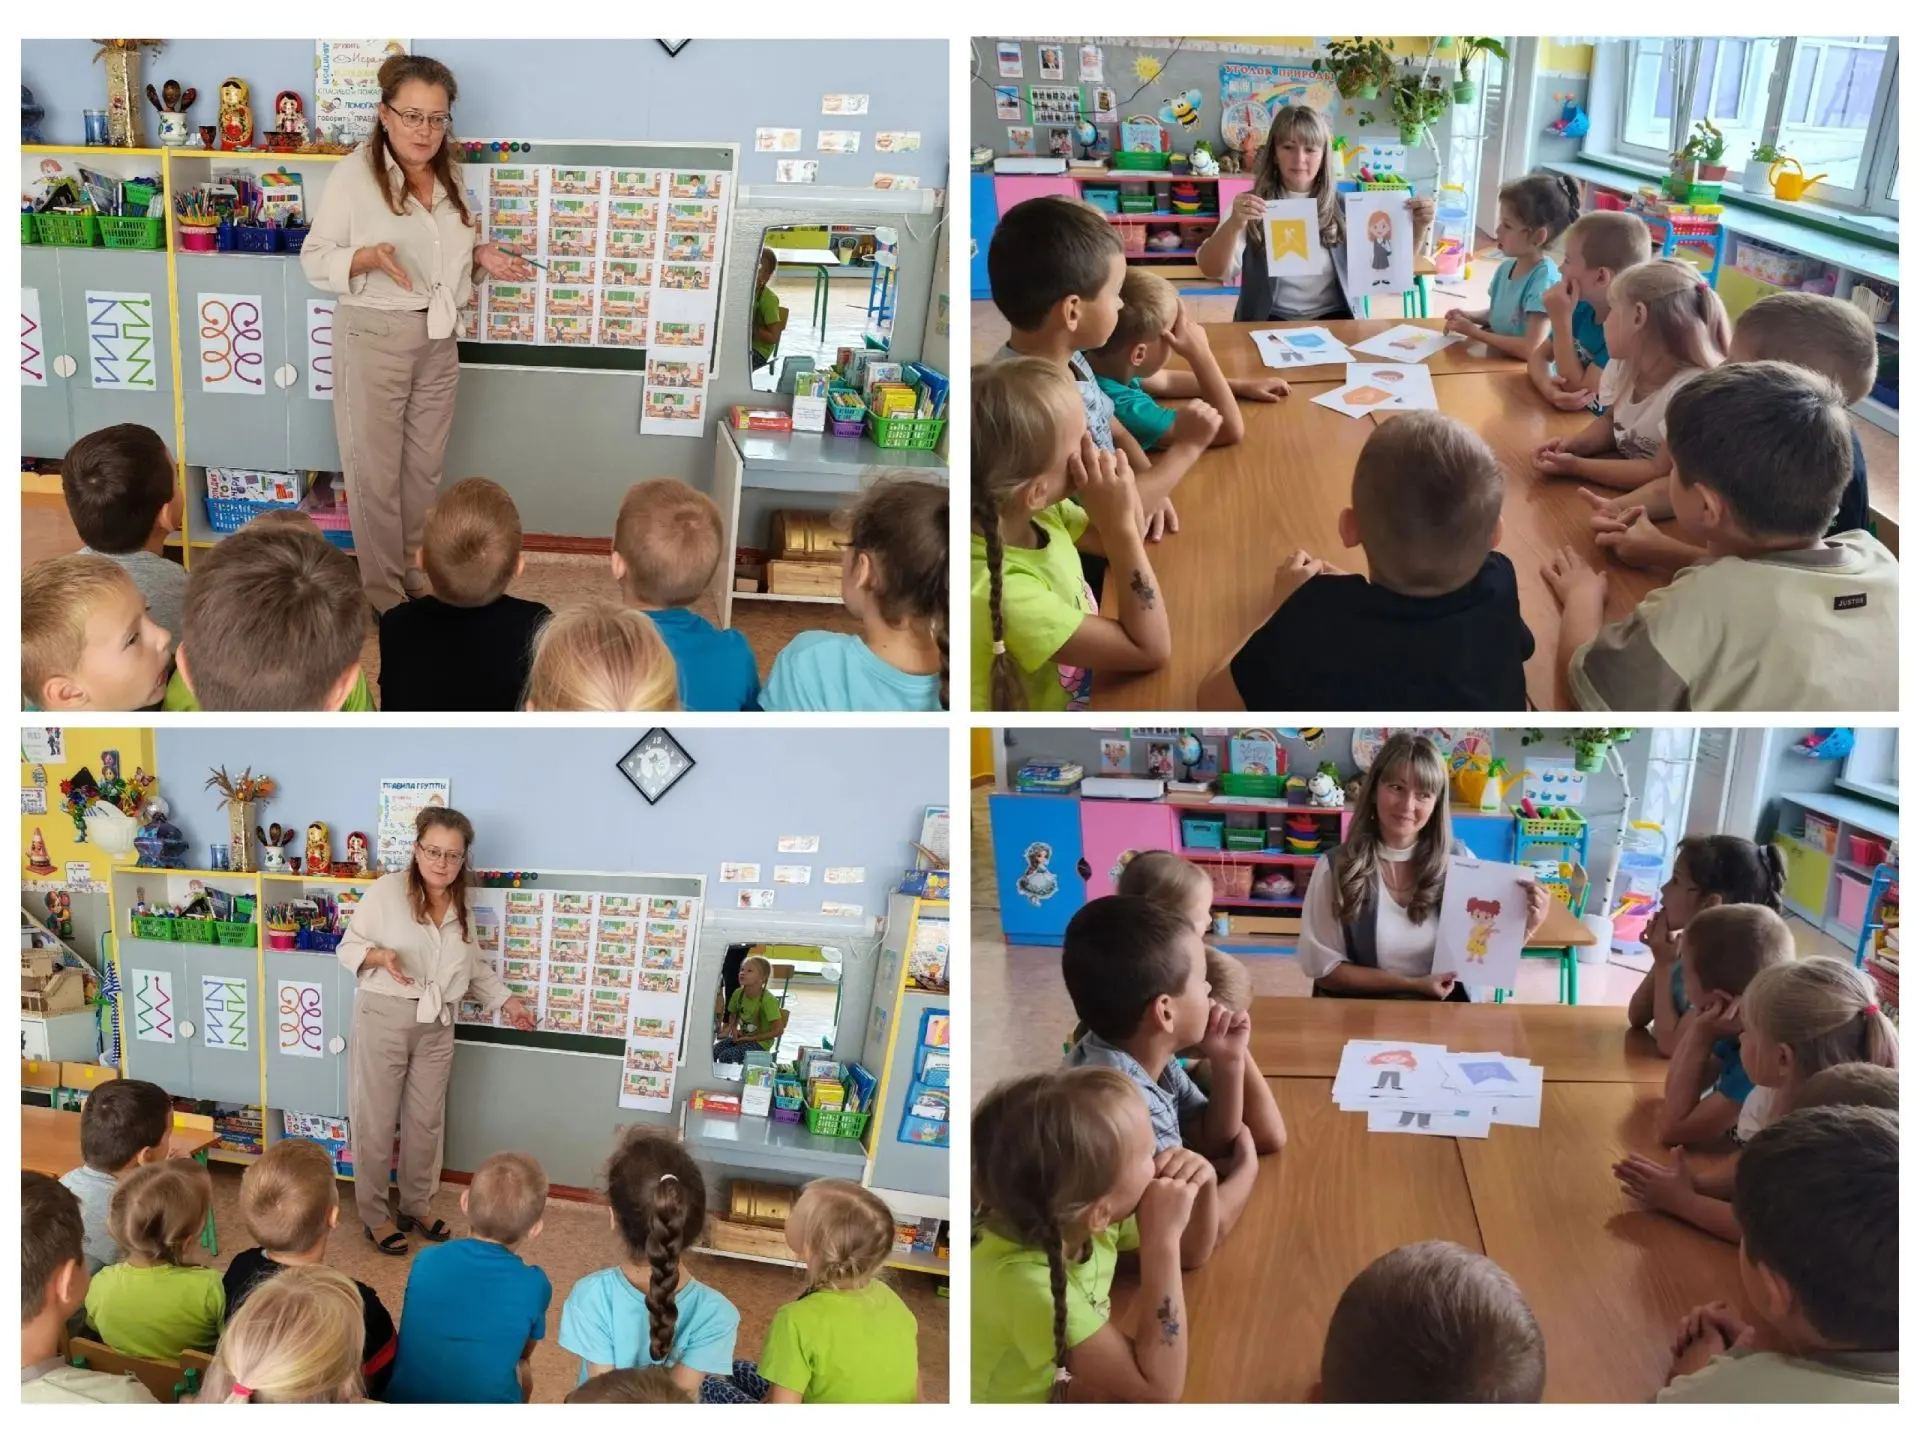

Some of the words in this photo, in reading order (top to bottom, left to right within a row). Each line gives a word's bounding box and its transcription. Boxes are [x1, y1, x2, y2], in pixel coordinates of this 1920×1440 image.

[1225, 66, 1272, 76] УГОЛОК
[1279, 69, 1337, 80] ПРИРОДЫ
[652, 736, 662, 744] 12
[382, 782, 416, 790] ПРАВИЛА
[416, 782, 447, 790] ГРУППЫ
